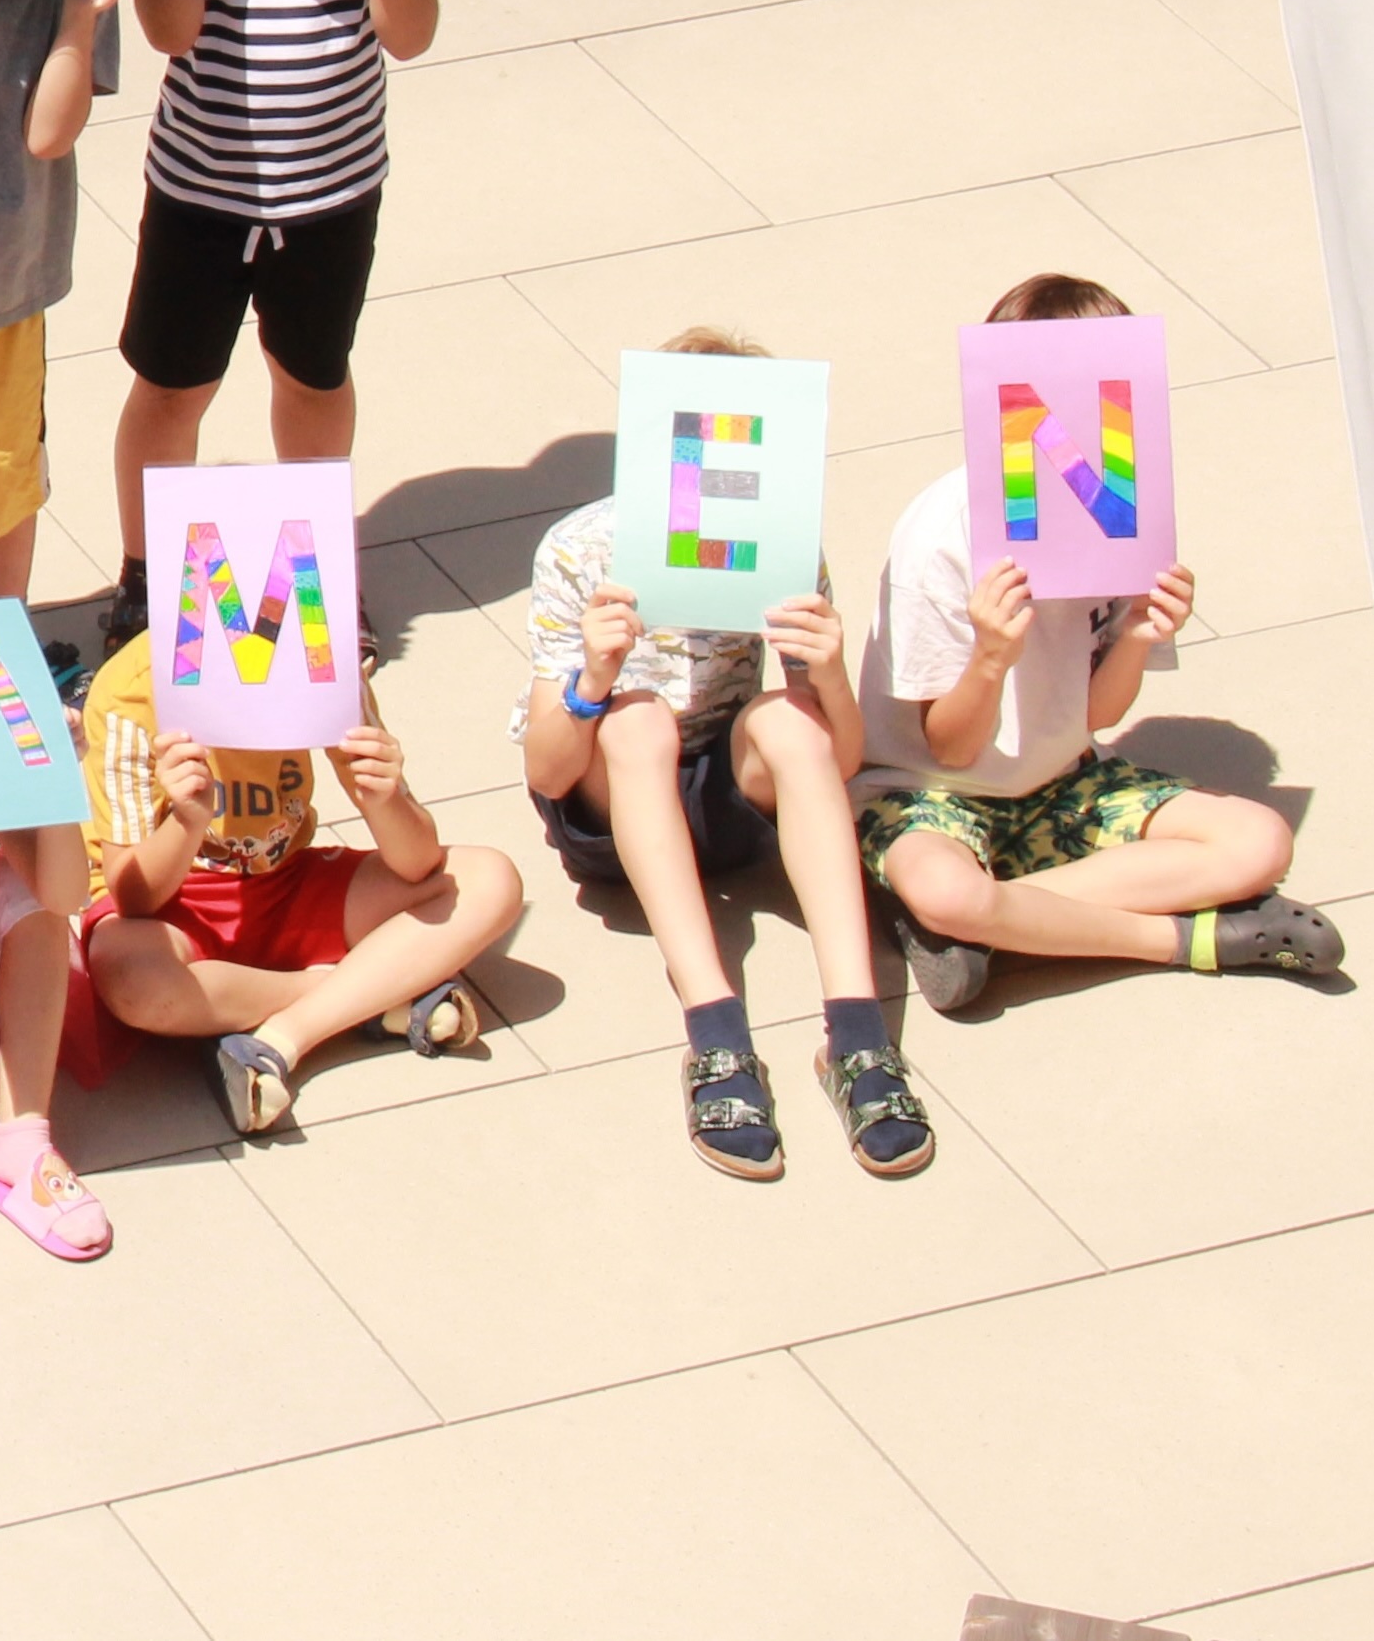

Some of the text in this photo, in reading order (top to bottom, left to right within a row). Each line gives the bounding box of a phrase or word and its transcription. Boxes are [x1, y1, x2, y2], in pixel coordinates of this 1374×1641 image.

[665, 410, 763, 573] E
[997, 378, 1139, 542] N
[172, 519, 337, 686] M
